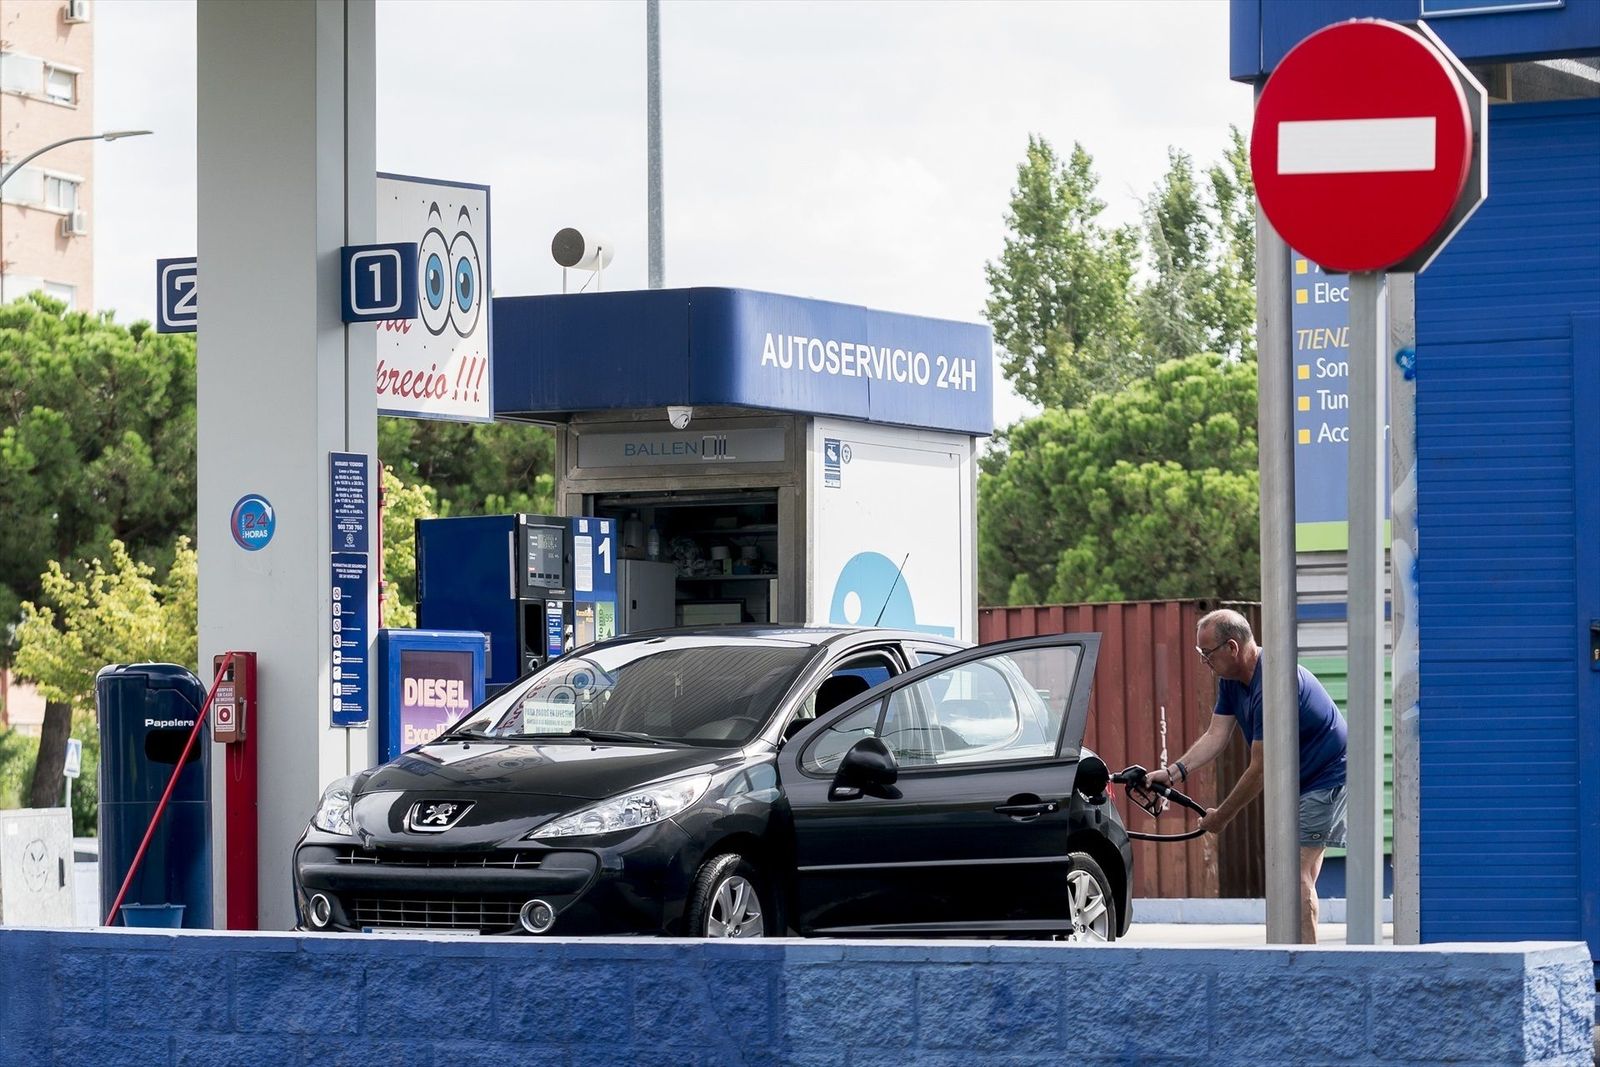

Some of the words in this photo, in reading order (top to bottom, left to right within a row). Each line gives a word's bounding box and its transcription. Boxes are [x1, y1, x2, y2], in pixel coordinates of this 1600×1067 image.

[368, 262, 382, 302] 1
[1315, 282, 1349, 303] Elec
[174, 275, 198, 315] 2
[761, 333, 931, 387] AUTOSERVICIO
[936, 355, 976, 392] 24H
[1316, 358, 1349, 379] Son
[1317, 389, 1349, 410] Tun
[245, 513, 268, 529] 24
[244, 530, 268, 539] HORAS
[598, 537, 612, 574] 1
[404, 677, 469, 709] DIESEL
[144, 718, 195, 729] Papelera
